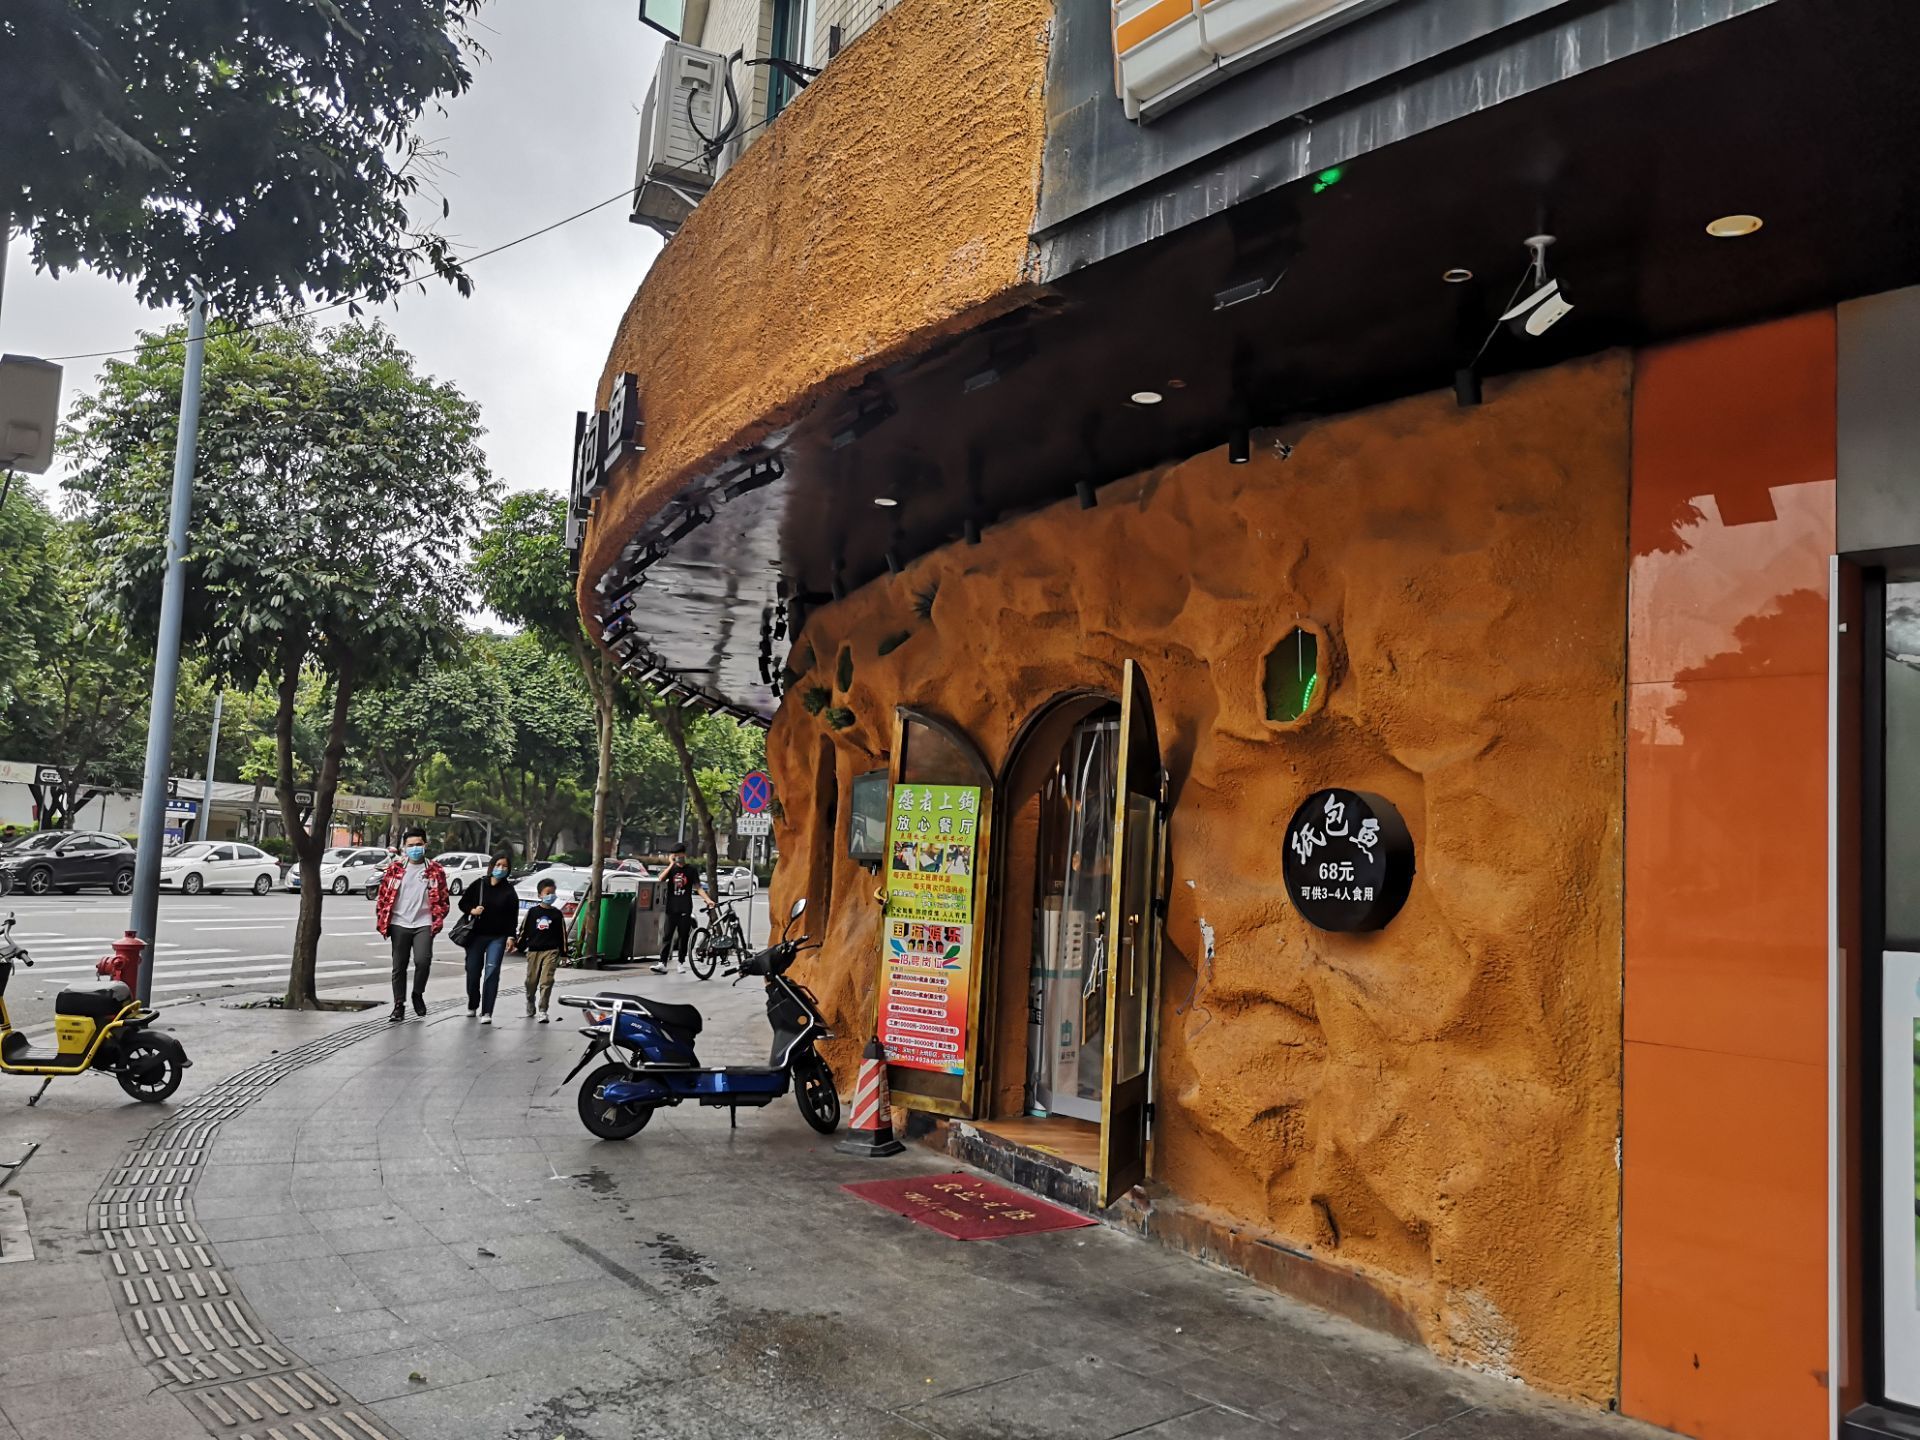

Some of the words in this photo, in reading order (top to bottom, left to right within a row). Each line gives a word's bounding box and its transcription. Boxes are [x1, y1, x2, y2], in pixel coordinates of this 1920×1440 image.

[896, 815, 974, 834] 放心餐厅
[1291, 793, 1380, 865] 纸包鱼
[1319, 861, 1355, 881] 68元
[1301, 886, 1374, 901] 可供3-4人食用
[900, 953, 943, 968] 招聘岗位
